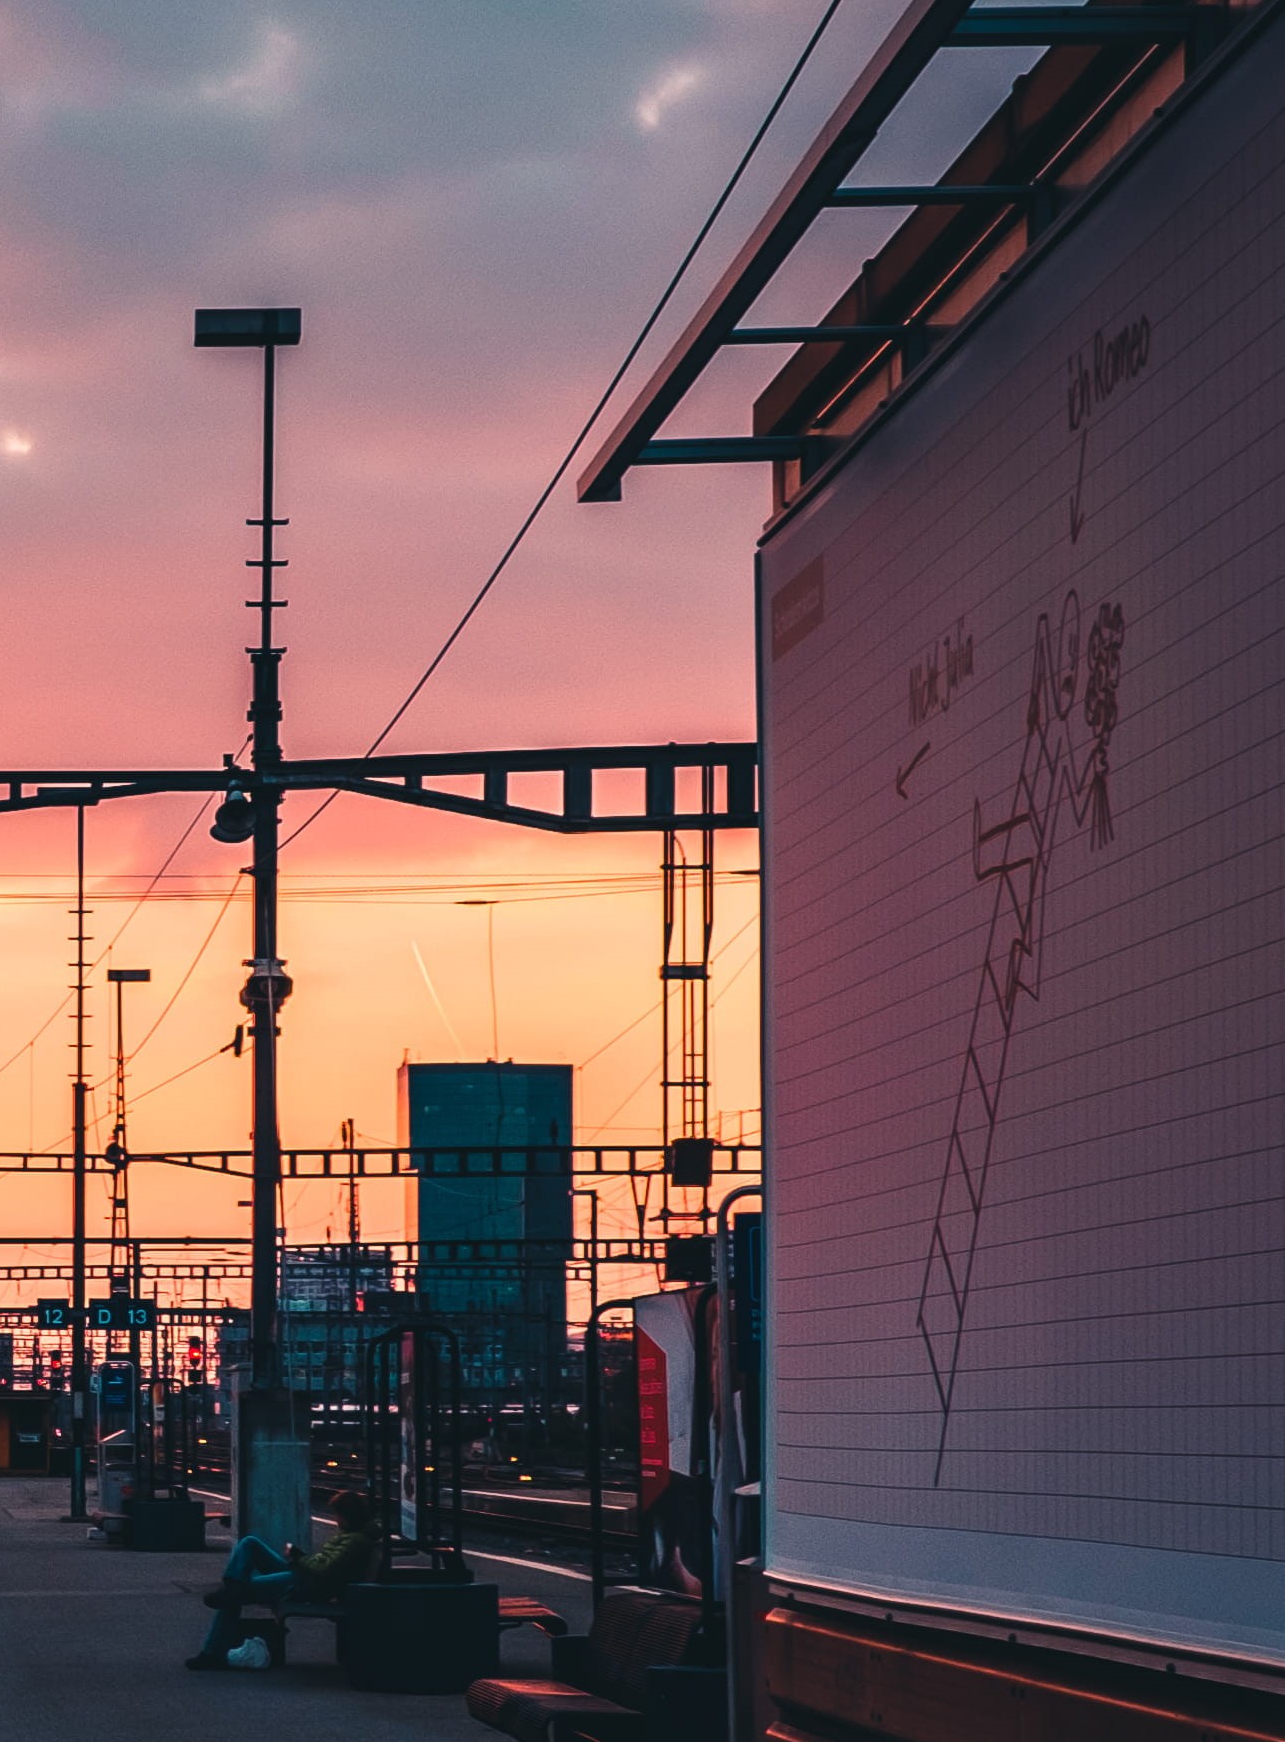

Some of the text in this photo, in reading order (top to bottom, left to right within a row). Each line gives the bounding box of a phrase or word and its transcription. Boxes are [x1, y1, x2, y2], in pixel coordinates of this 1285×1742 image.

[1094, 315, 1150, 402] Romeo
[45, 1309, 63, 1324] 12
[97, 1309, 111, 1325] D
[128, 1309, 147, 1325] 13
